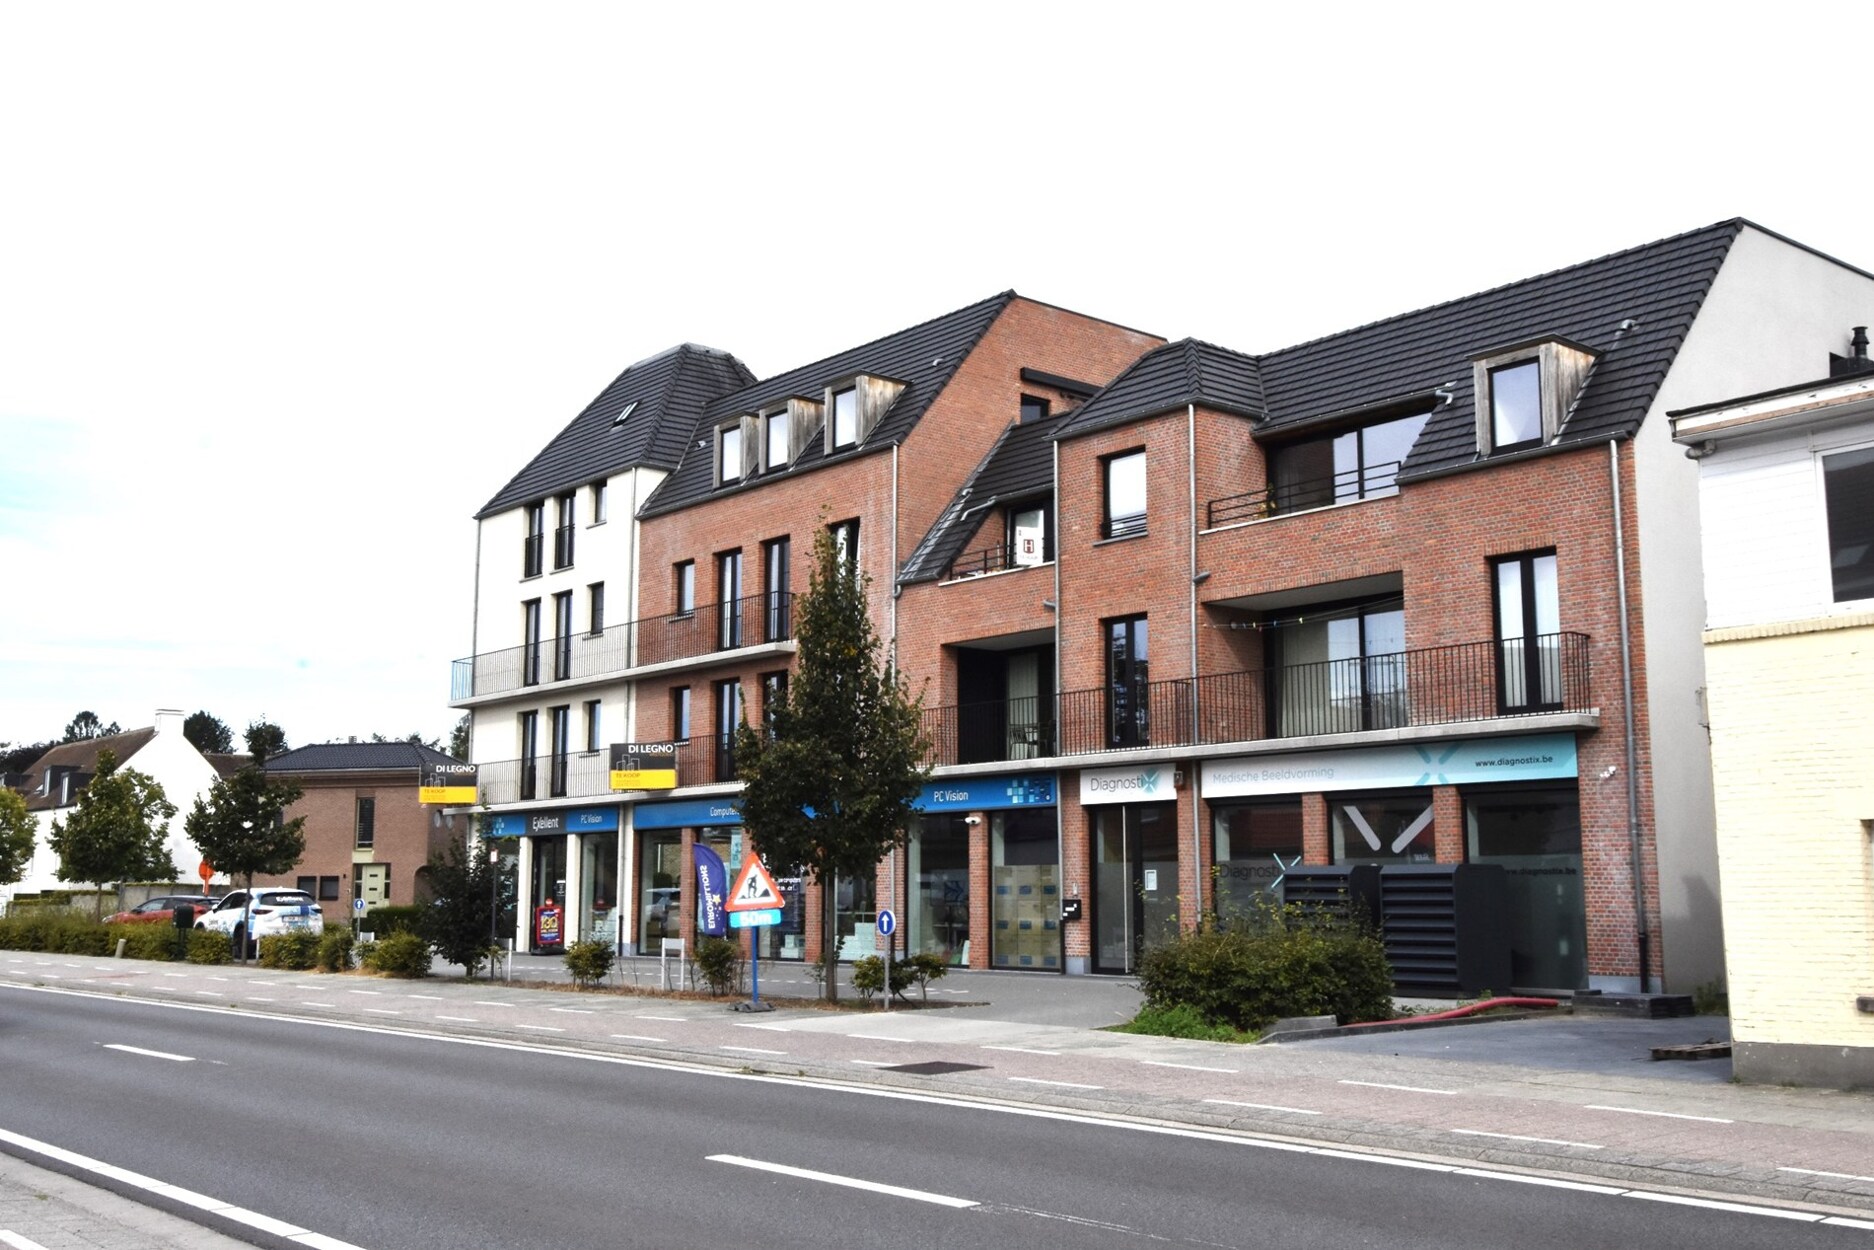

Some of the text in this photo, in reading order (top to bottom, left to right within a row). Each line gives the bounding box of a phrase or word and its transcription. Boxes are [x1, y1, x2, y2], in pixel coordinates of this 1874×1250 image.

[628, 744, 673, 753] DI LEGNO
[1475, 755, 1553, 768] www.diagnostix.be
[436, 765, 476, 773] DI LEGNO
[1213, 768, 1334, 784] Medische Beeldvorming
[933, 790, 968, 802] PC Vision
[580, 814, 603, 824] PC Vision
